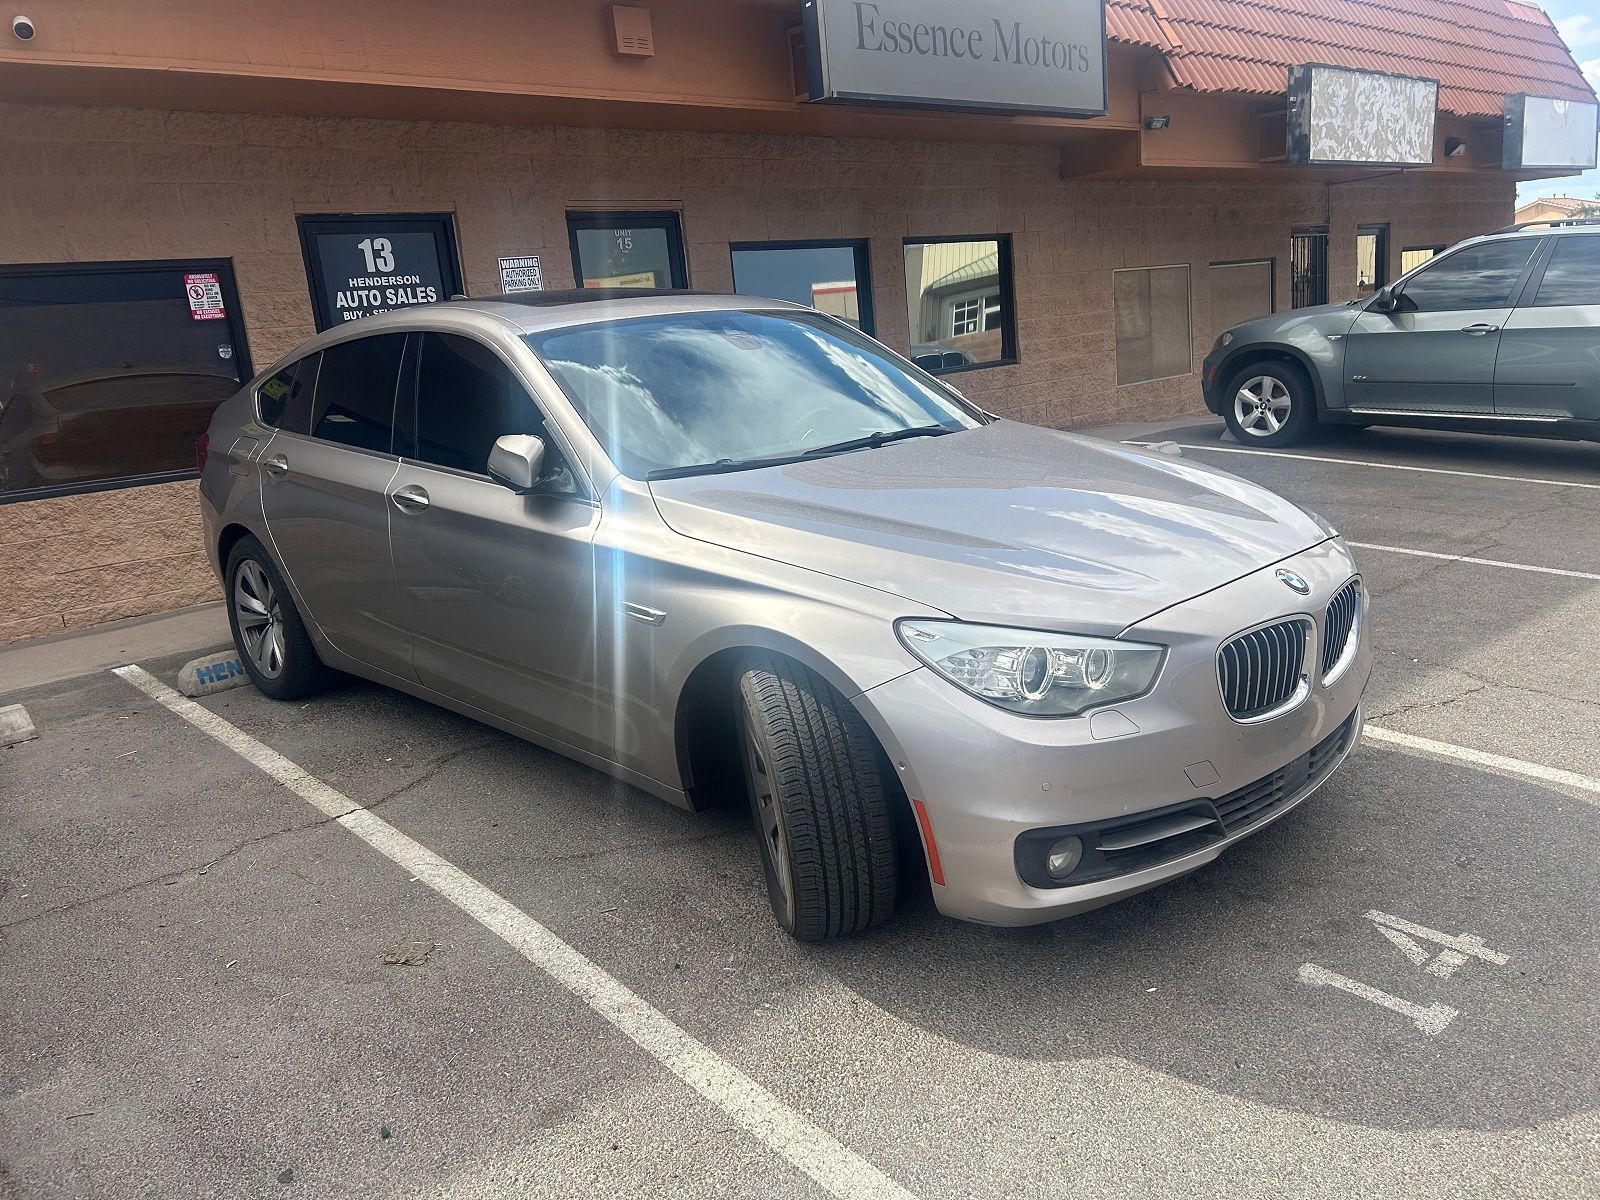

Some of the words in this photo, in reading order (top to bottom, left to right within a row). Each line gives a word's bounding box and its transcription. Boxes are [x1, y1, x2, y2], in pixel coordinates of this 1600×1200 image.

[853, 1, 984, 60] Essence
[991, 18, 1090, 73] Motors
[614, 229, 632, 237] UNIT
[616, 237, 633, 250] 15
[357, 237, 396, 273] 13
[501, 258, 539, 269] WARNING
[505, 268, 537, 279] AUTHORIZED
[349, 275, 420, 288] HENDERSON
[504, 278, 527, 288] PARKING
[527, 277, 540, 287] ONLY
[336, 289, 382, 309] AUTO
[386, 286, 437, 305] SALES
[343, 310, 363, 321] BUY
[195, 658, 244, 685] HEN
[1295, 908, 1511, 1036] 14
